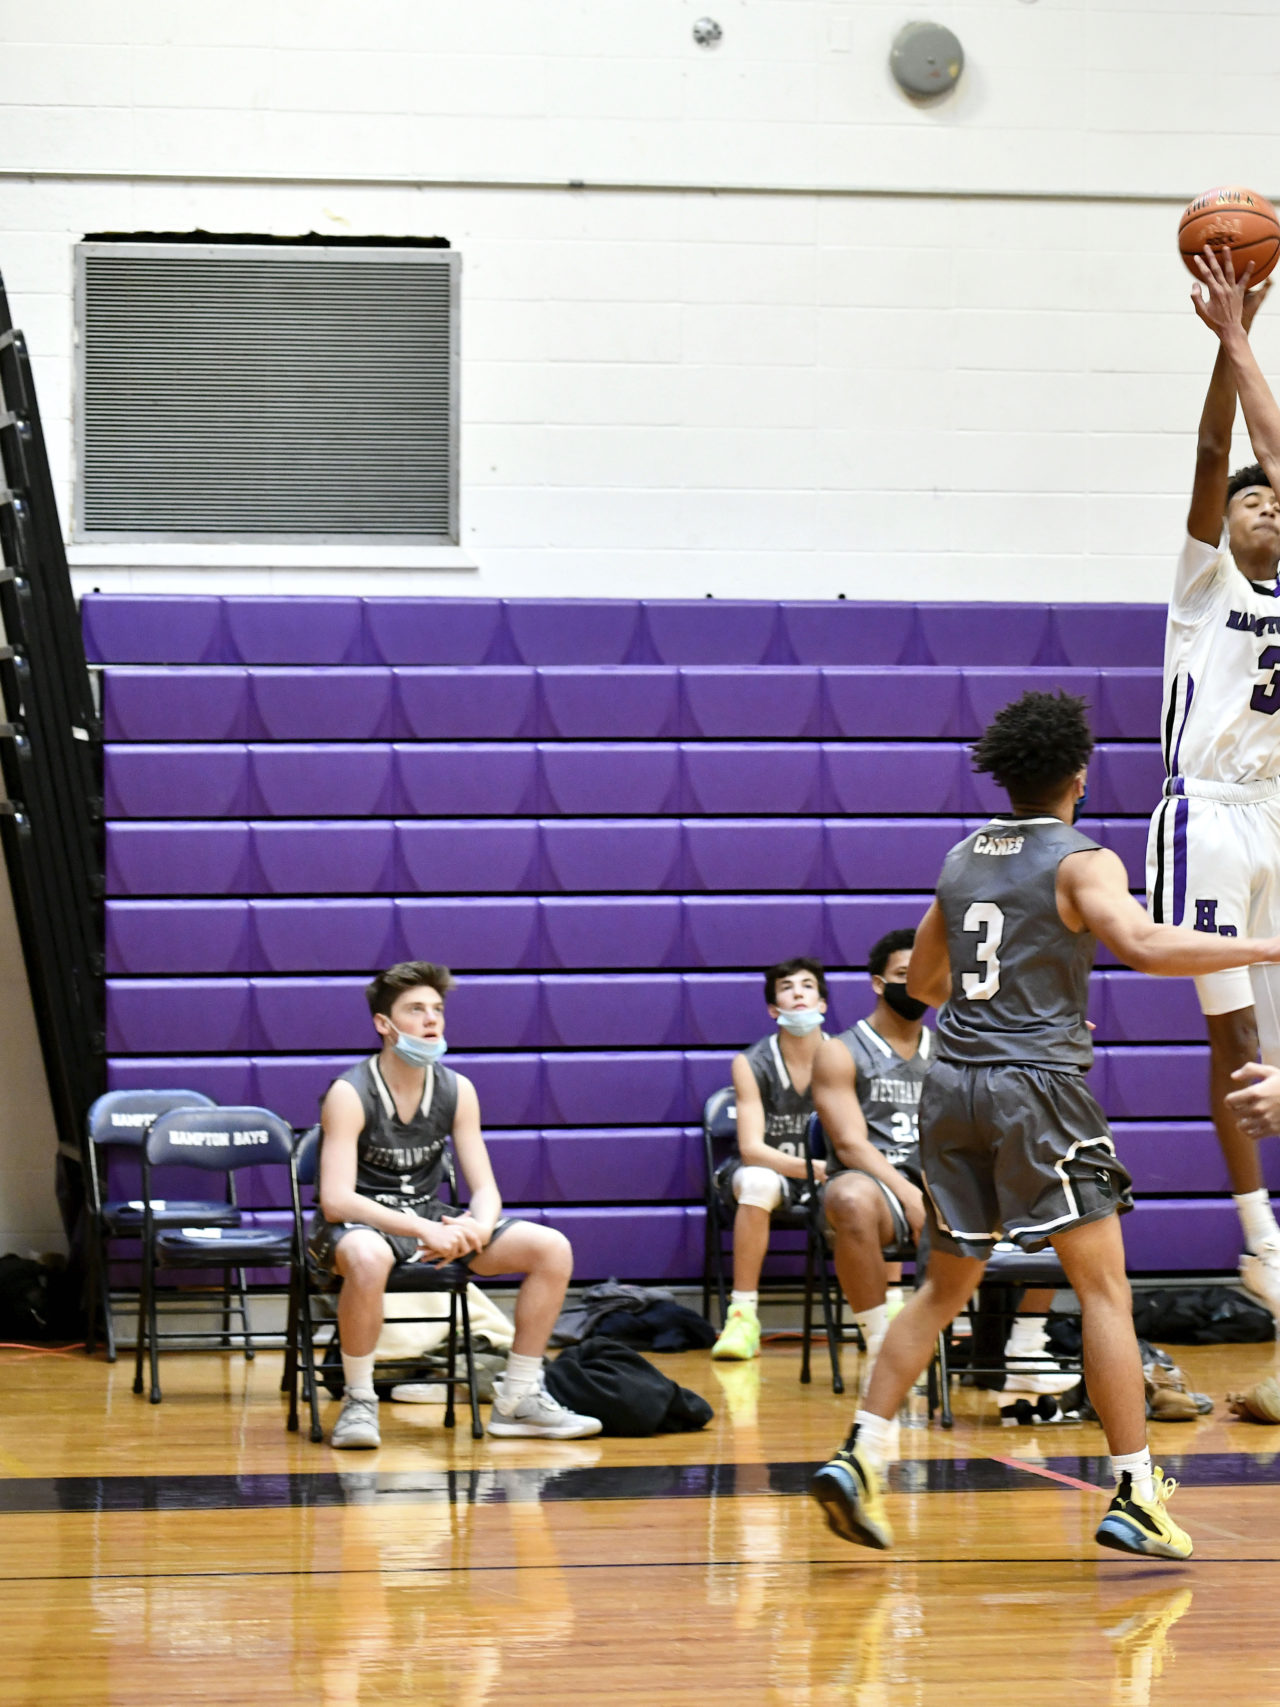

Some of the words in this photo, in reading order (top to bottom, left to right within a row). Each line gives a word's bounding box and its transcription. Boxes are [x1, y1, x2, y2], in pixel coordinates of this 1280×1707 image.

[973, 835, 1025, 856] CANES
[961, 902, 1005, 1000] 3
[111, 1113, 158, 1127] HAMPT
[169, 1130, 230, 1146] HAMPTON
[232, 1130, 269, 1146] BAYS
